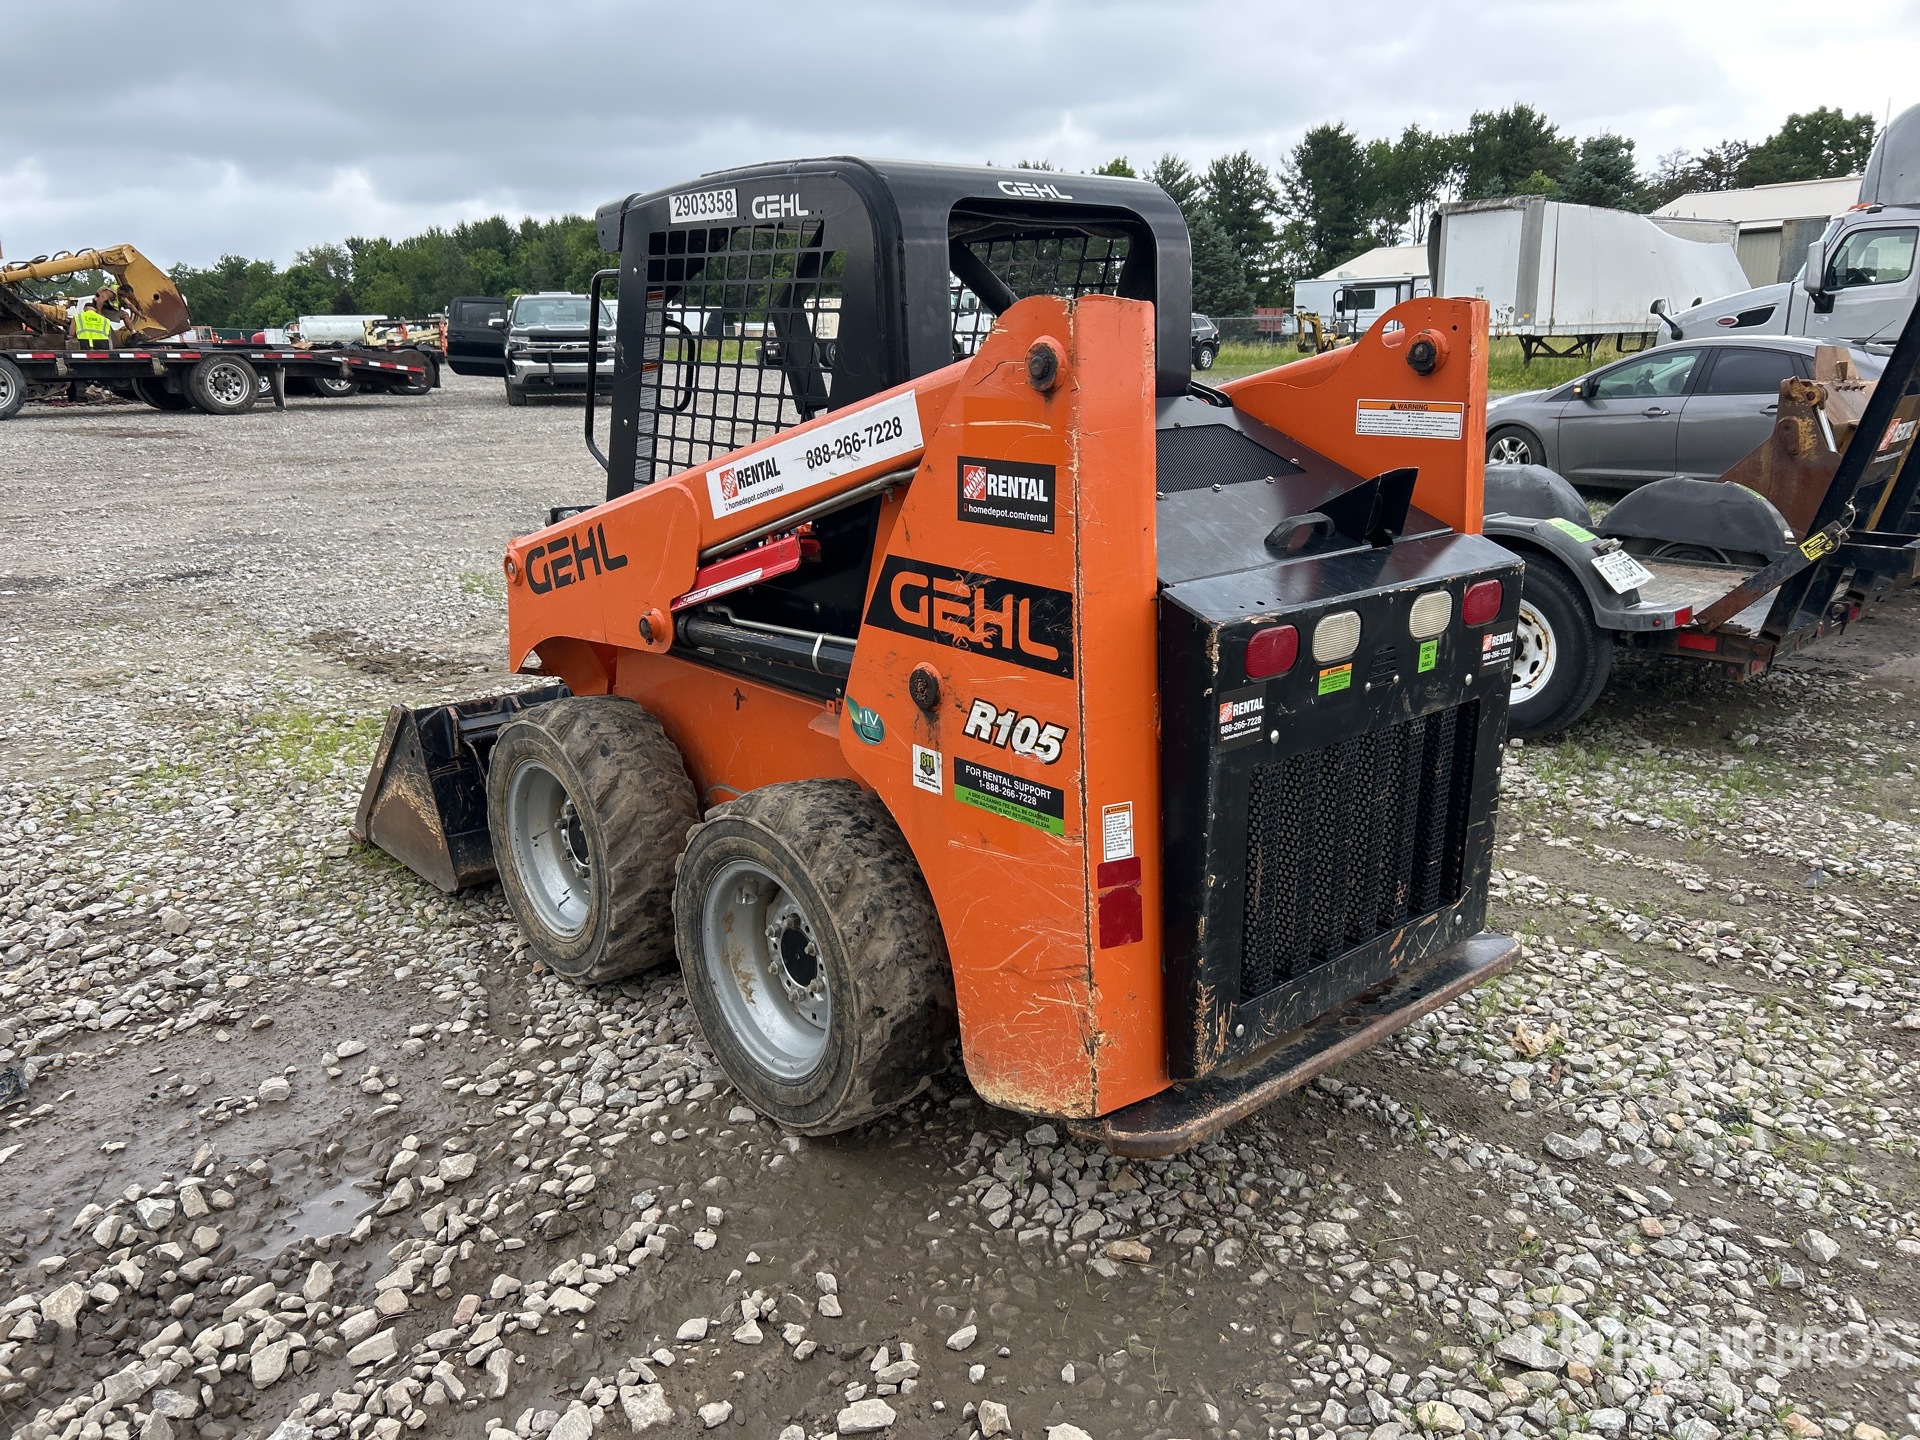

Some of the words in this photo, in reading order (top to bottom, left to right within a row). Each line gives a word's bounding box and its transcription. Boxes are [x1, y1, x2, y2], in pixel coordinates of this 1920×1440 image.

[997, 180, 1073, 200] GEHL
[674, 190, 733, 217] 2903358
[751, 193, 809, 219] GEHL
[1397, 403, 1429, 411] WARNING
[805, 416, 903, 469] 888-266-7228
[736, 456, 781, 490] RENTAL
[728, 483, 785, 510] homedepot.com/rental
[987, 473, 1049, 503] RENTAL
[968, 503, 1048, 523] homedepot.com/rental
[525, 522, 628, 595] GEHL
[890, 571, 1059, 661] GEHL
[1421, 645, 1435, 653] CHECK
[1491, 631, 1514, 646] RENTAL
[864, 710, 879, 726] IV
[1233, 697, 1264, 716] RENTAL
[963, 698, 1068, 764] R105
[1220, 716, 1262, 734] 888-266-7228
[920, 752, 934, 769] 811
[965, 765, 981, 777] FOR
[982, 770, 1012, 788] RENTAL
[1013, 780, 1052, 800] SUPPORT
[978, 779, 1037, 806] 1-888-266-7228
